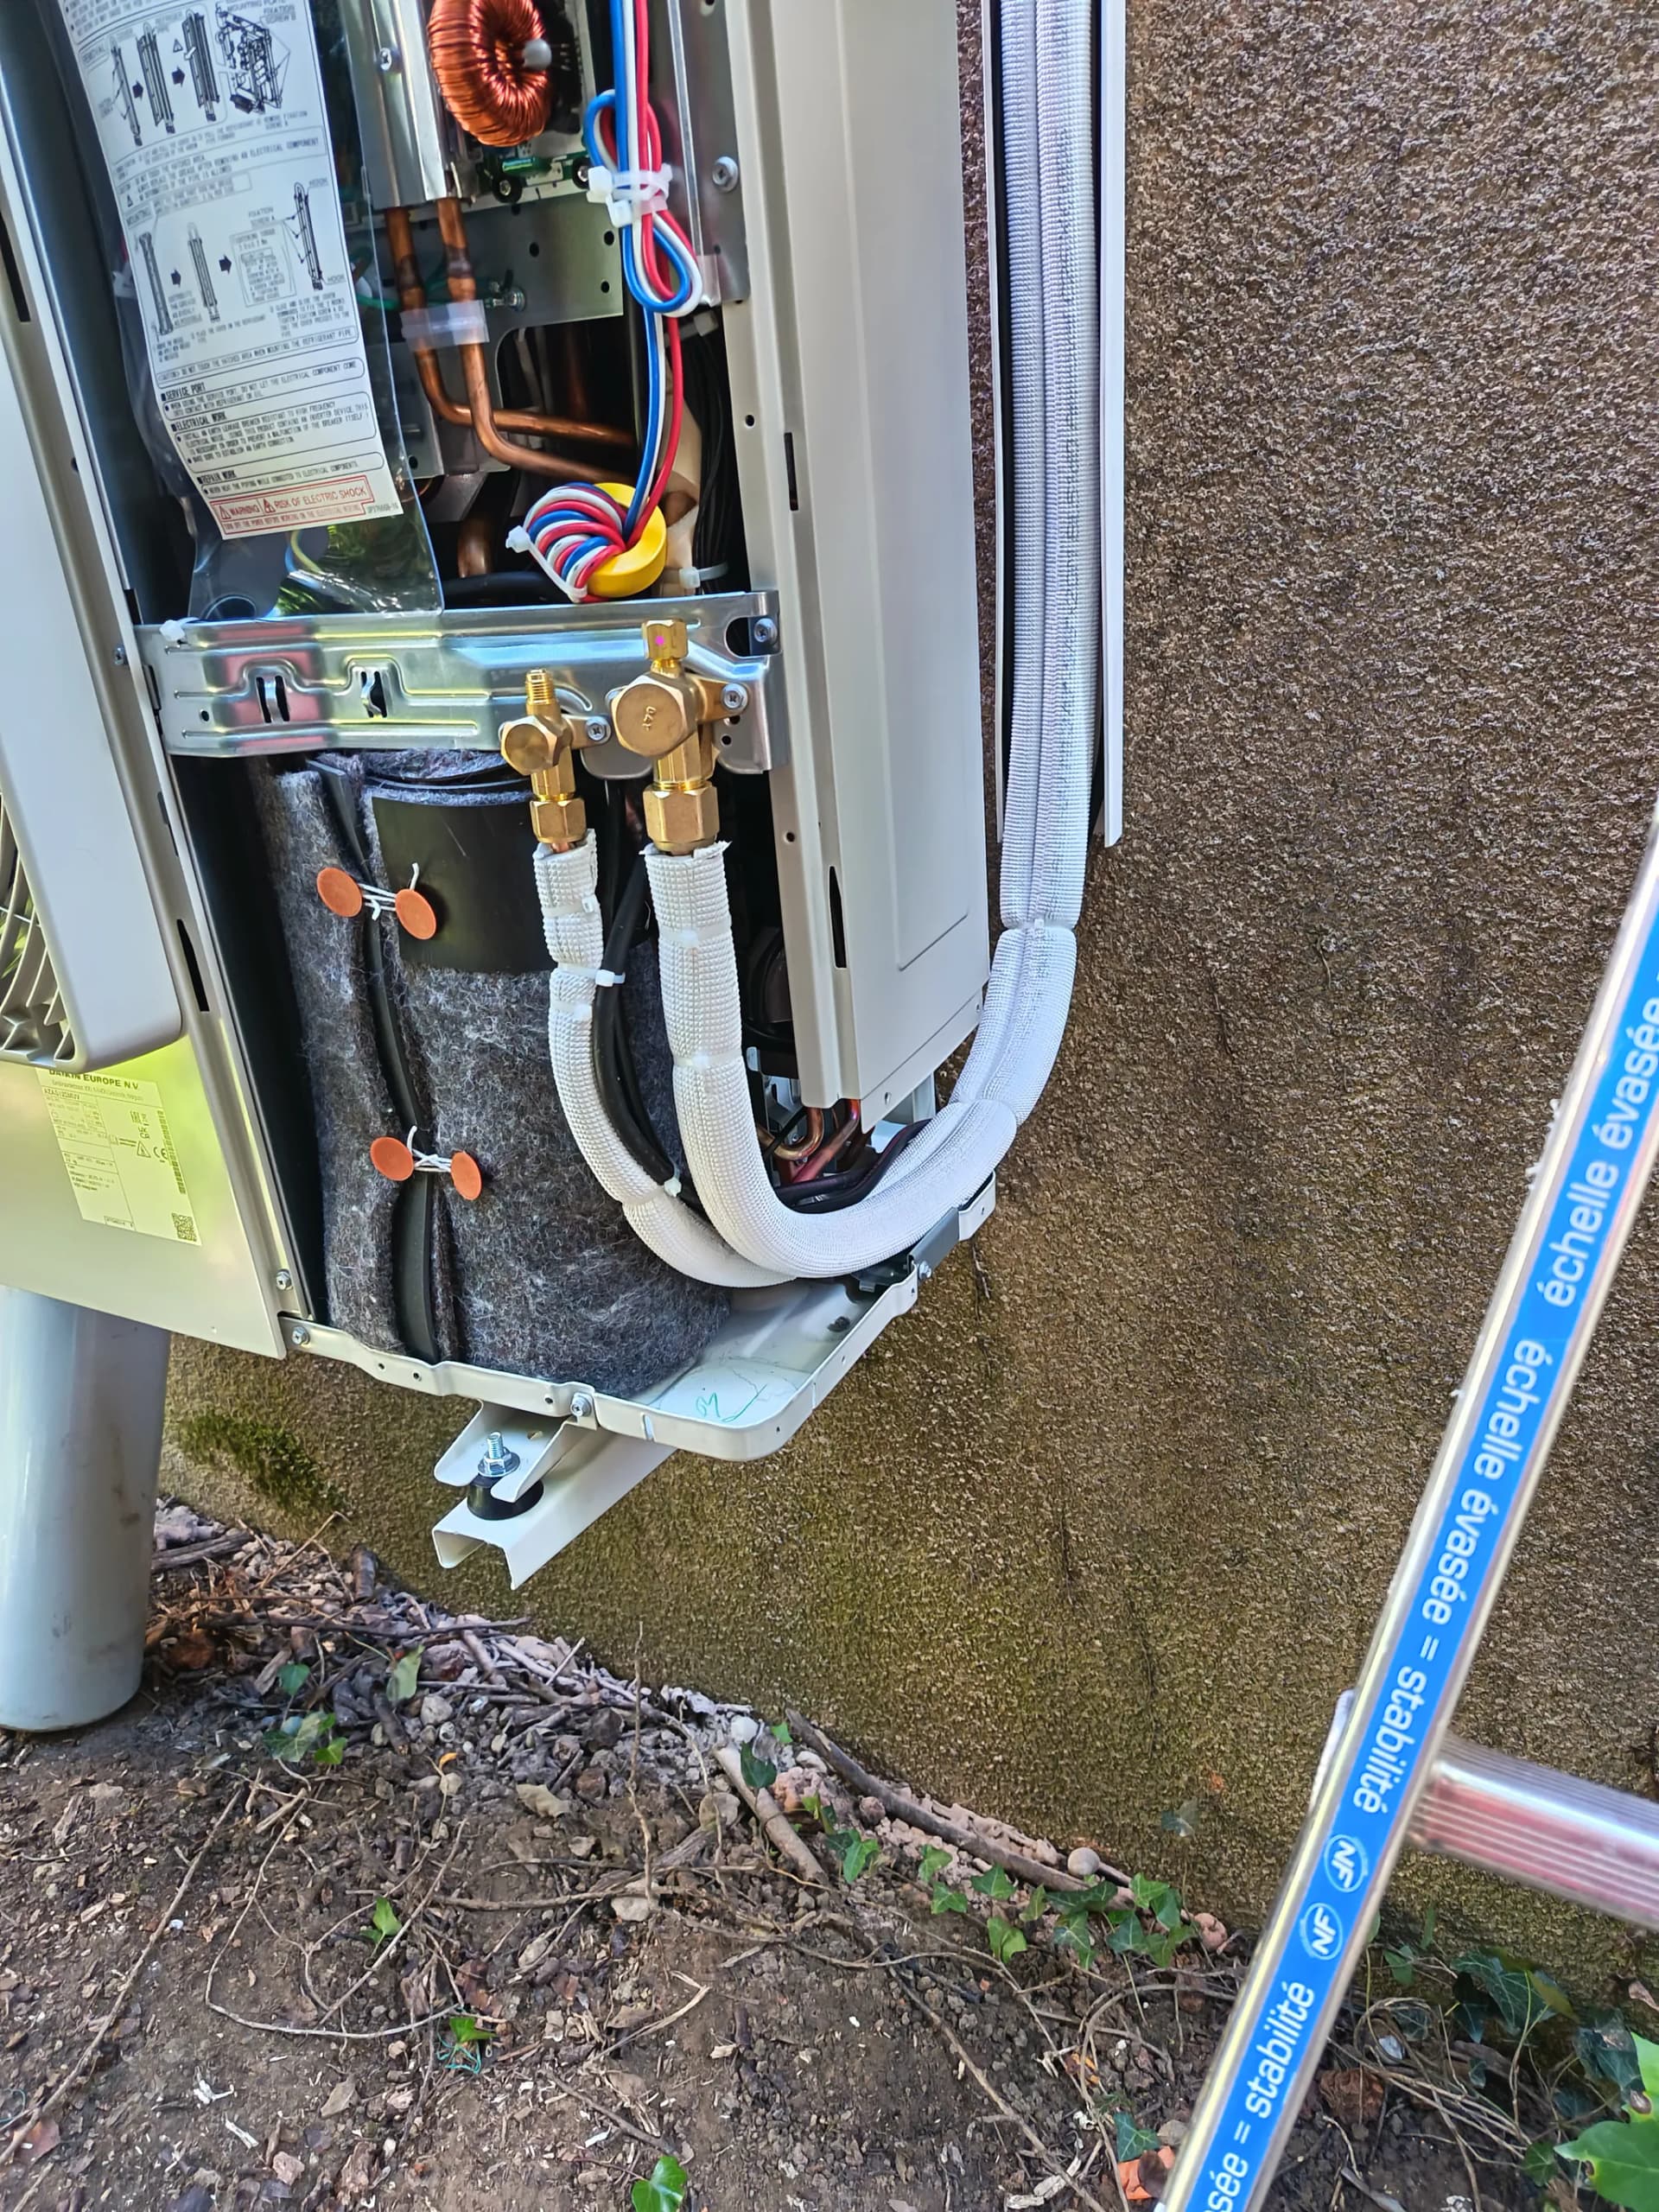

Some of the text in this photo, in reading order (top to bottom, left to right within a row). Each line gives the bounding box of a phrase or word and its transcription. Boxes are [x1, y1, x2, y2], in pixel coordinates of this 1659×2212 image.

[312, 364, 340, 376] COMPONENT
[165, 381, 206, 400] SERVICE PORT
[175, 410, 226, 430] ELECTRICAL WORK
[200, 469, 236, 483] REPAIR WORK
[229, 486, 366, 516] WARNING RISK OF ELECTRIC SHOCK
[83, 1074, 122, 1087] EUROPE
[1542, 1161, 1618, 1306] échelle
[1473, 1339, 1554, 1480] échelle
[1422, 1489, 1498, 1625] évasée
[1353, 1665, 1427, 1815] stabilité
[1204, 2152, 1249, 2212] sée
[1245, 1981, 1315, 2119] stabilité
